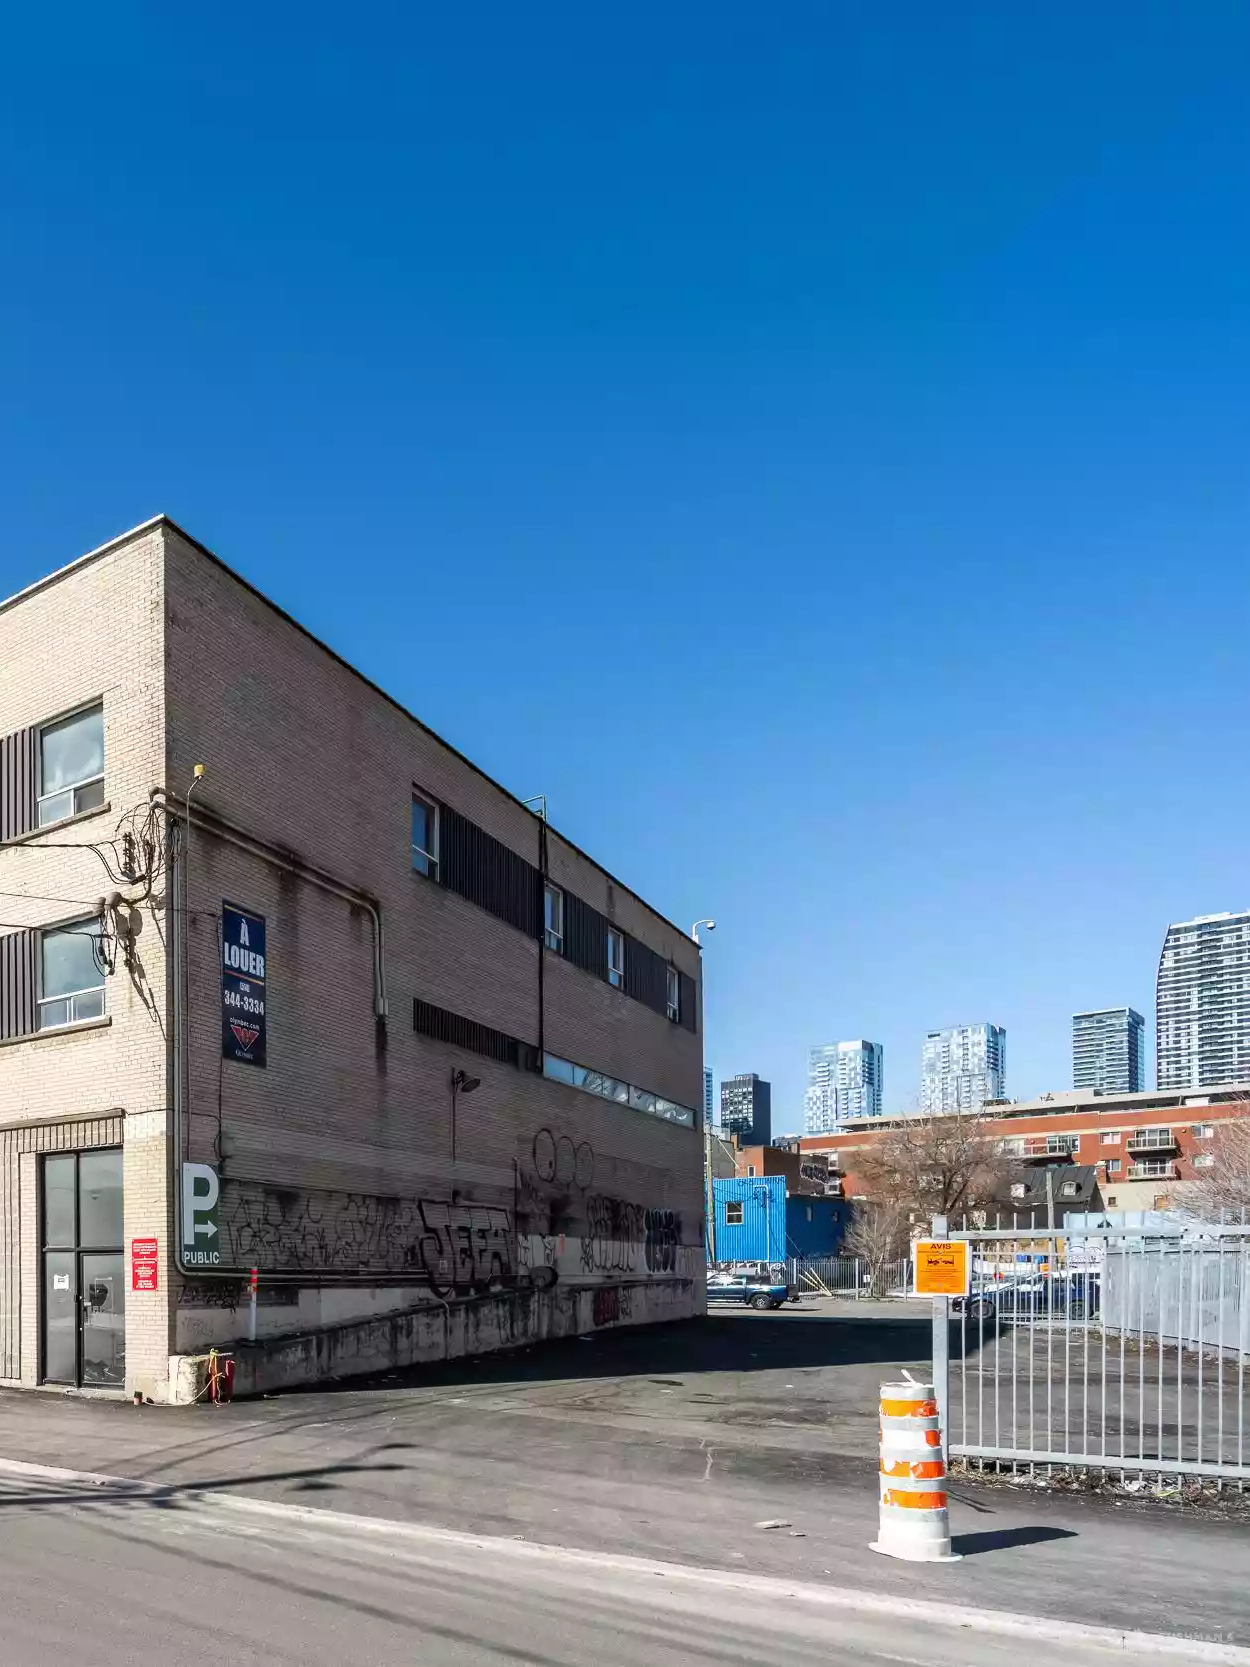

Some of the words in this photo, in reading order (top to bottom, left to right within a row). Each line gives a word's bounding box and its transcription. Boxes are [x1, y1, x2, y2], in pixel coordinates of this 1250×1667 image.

[239, 918, 250, 946] À
[224, 942, 265, 977] LOUER
[224, 990, 265, 1016] 344-3334
[183, 1162, 219, 1245] P
[184, 1251, 220, 1265] PUBLIC
